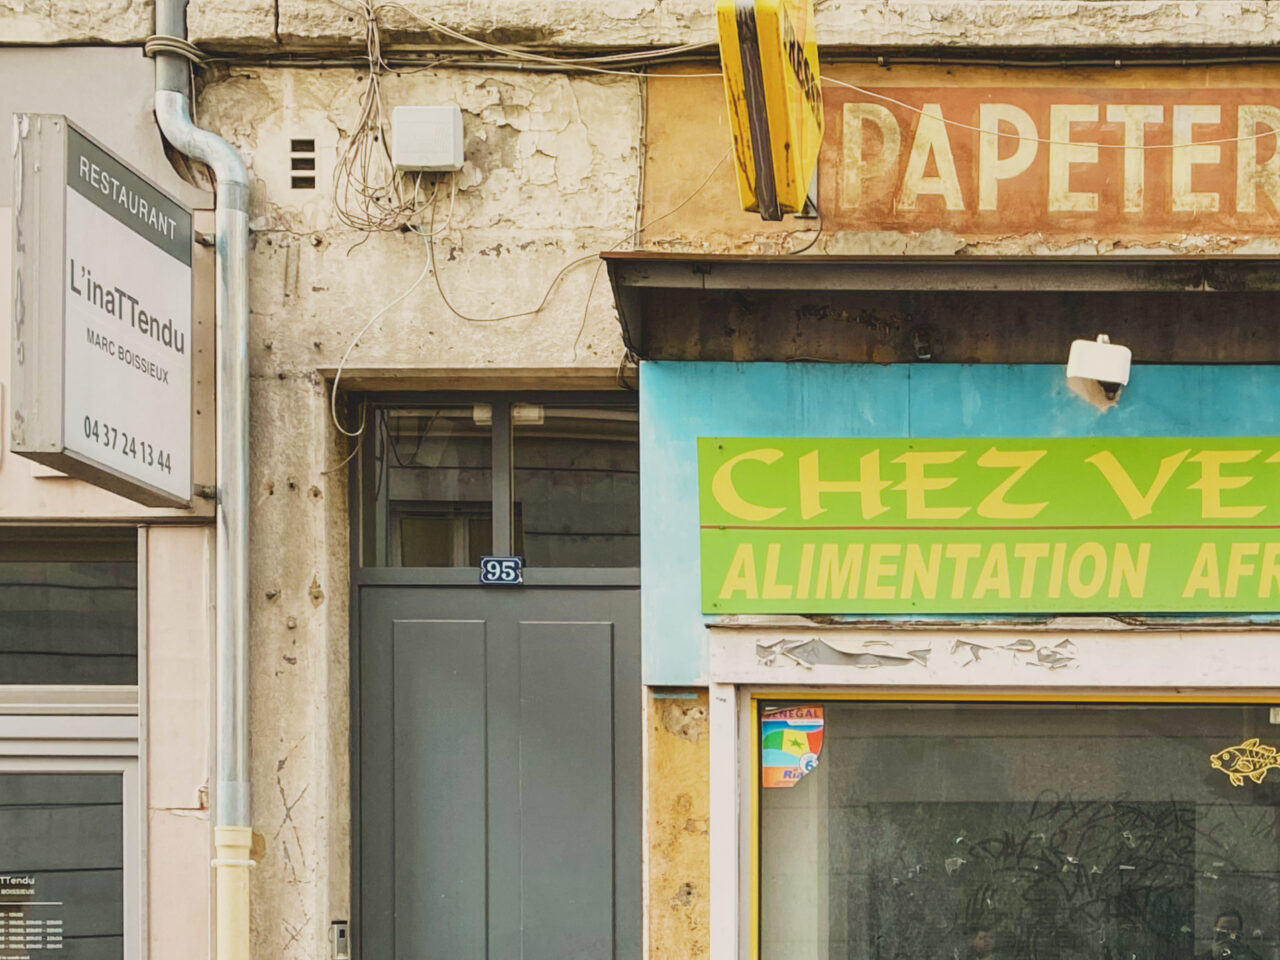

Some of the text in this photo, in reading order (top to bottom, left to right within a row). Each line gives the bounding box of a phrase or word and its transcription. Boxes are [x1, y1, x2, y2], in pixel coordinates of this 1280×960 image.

[80, 155, 176, 240] RESTAURANT
[70, 258, 185, 355] L'inaTTendu
[86, 327, 169, 385] MARC BOISSIEUX
[84, 415, 172, 475] 04 37 24 13 44
[712, 447, 1050, 521] CHEZ
[486, 560, 516, 581] 95
[719, 542, 1152, 601] ALIMENTATION
